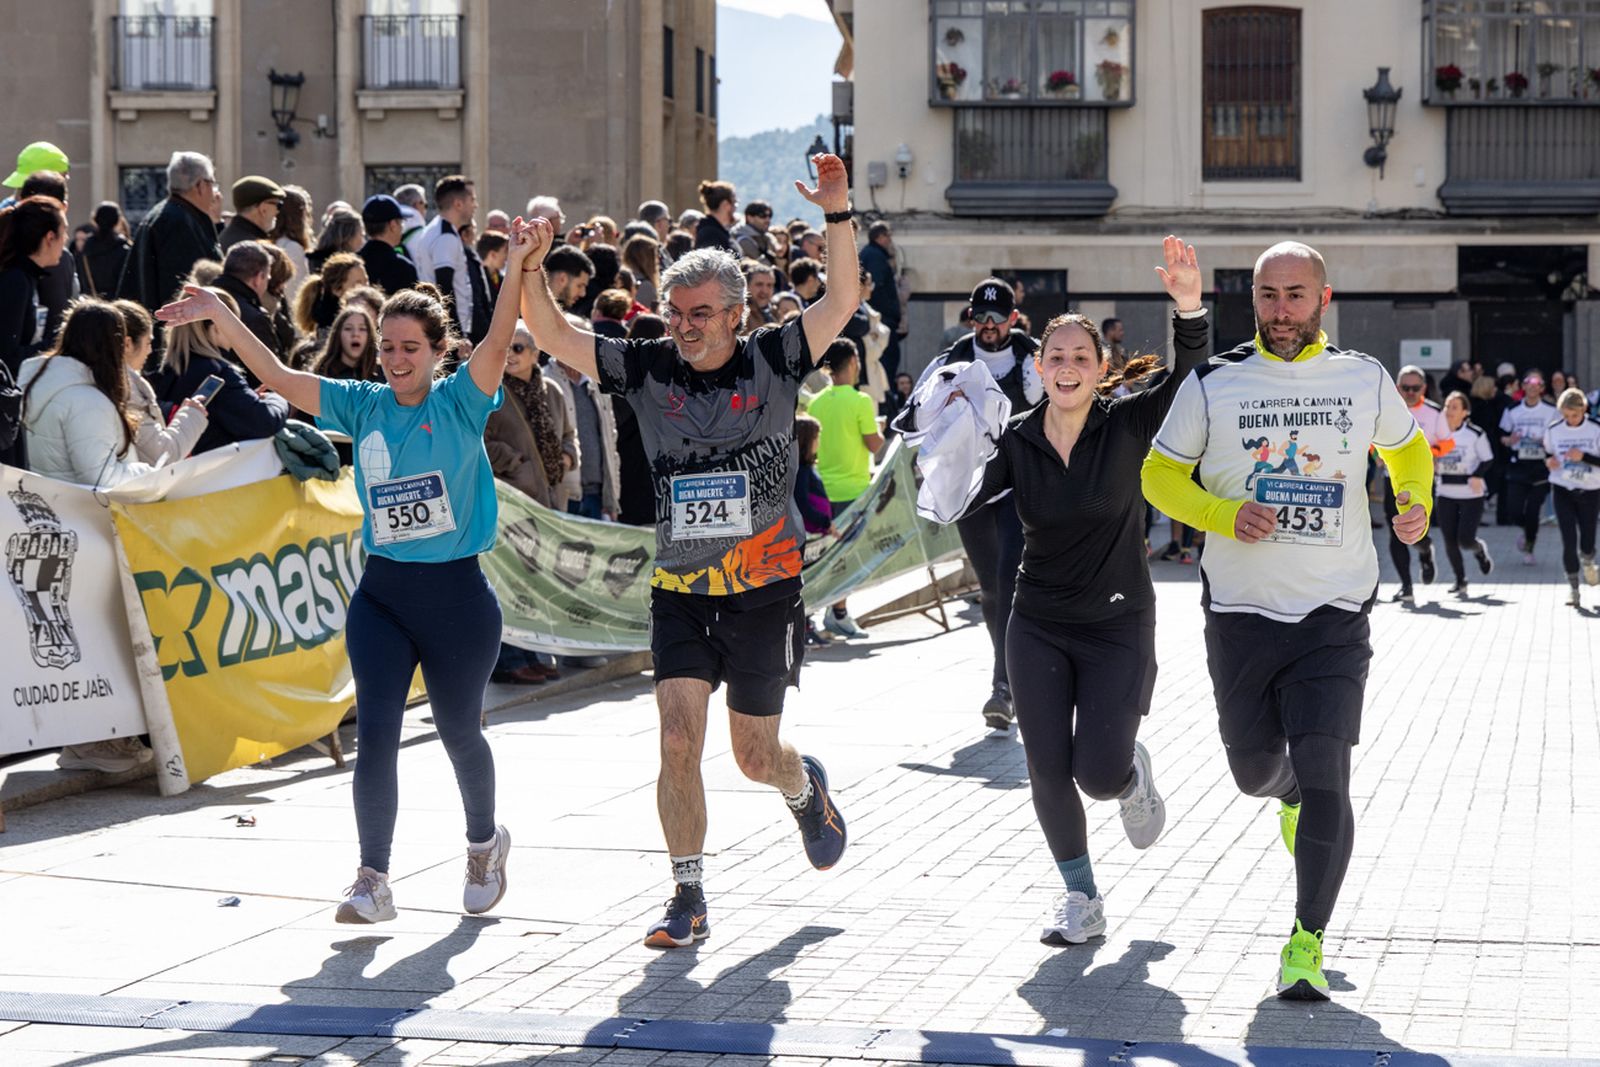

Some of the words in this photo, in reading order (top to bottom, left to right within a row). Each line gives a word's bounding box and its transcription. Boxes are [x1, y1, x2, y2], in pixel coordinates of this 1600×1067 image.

[1239, 400, 1250, 410] VI
[1251, 398, 1301, 409] CARRERA
[1302, 397, 1353, 407] CAMINATA
[1238, 413, 1279, 429] BUENA
[1283, 412, 1333, 427] MUERTE
[1265, 490, 1290, 502] BUENA
[1292, 492, 1322, 505] MUERTE
[388, 502, 430, 529] 550
[685, 500, 729, 525] 524
[1276, 506, 1324, 532] 453
[13, 683, 59, 707] CIUDAD
[62, 681, 80, 701] DE
[82, 674, 114, 699] JAÉN
